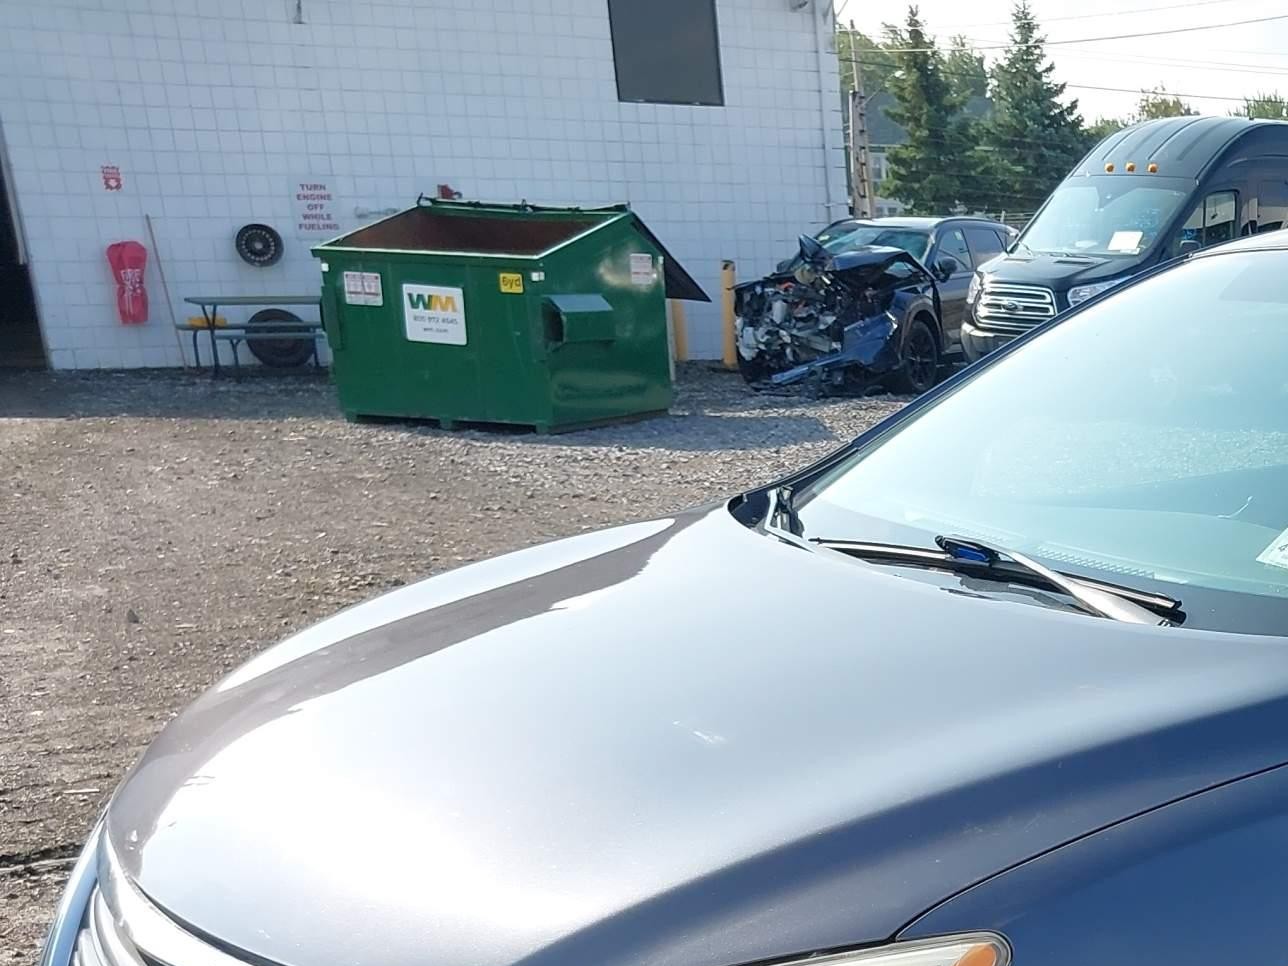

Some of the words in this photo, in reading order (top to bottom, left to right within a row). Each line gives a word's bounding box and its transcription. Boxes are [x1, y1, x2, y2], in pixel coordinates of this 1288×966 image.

[296, 193, 332, 201] ENGINE
[307, 203, 324, 211] OFF
[302, 213, 332, 221] WHILE
[298, 223, 340, 231] FUELING
[407, 292, 458, 313] WM
